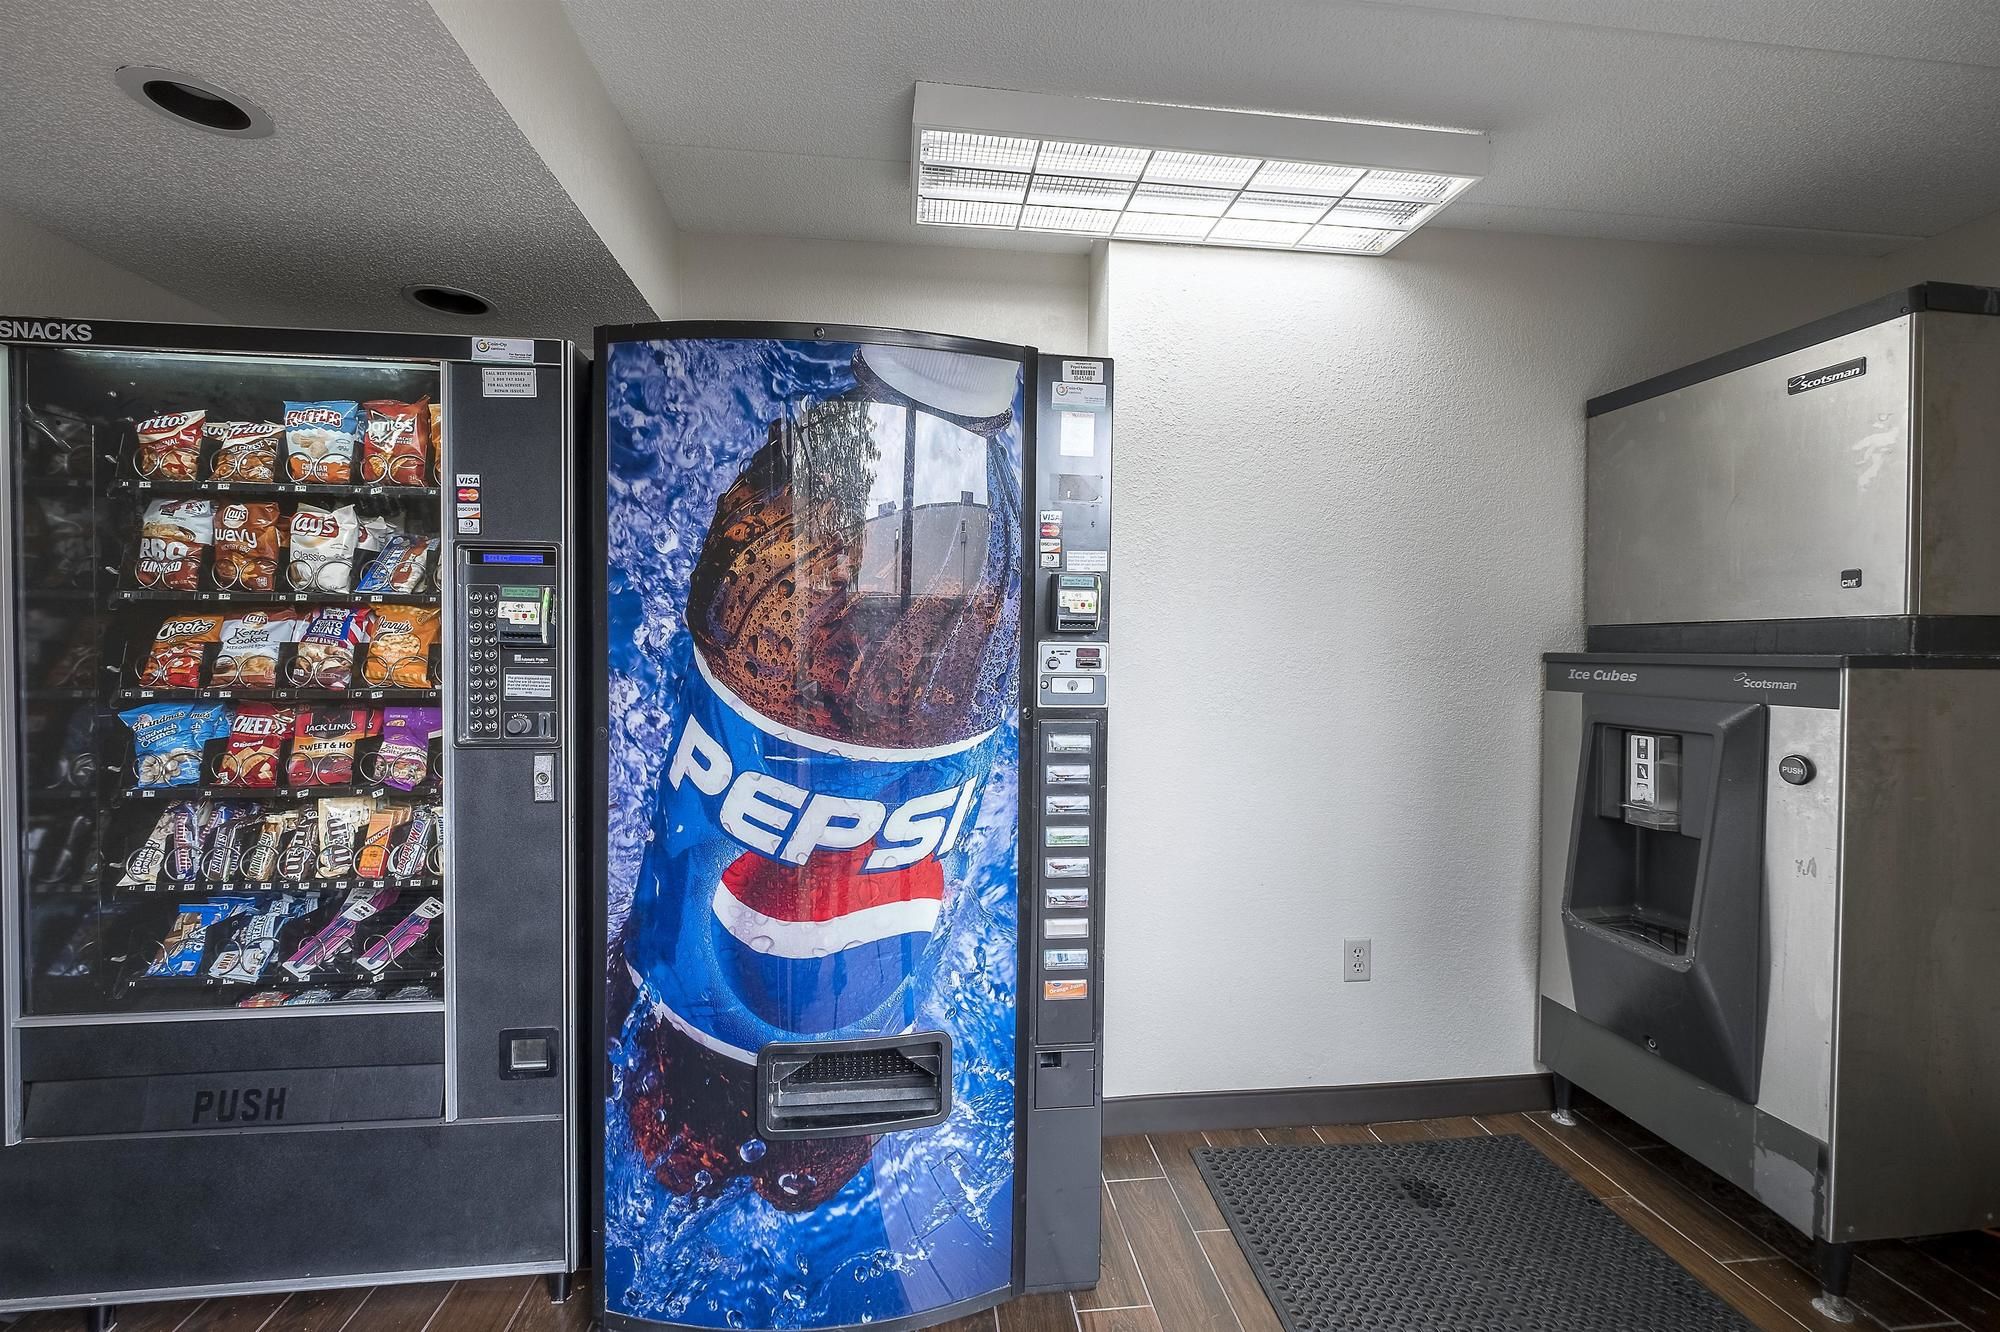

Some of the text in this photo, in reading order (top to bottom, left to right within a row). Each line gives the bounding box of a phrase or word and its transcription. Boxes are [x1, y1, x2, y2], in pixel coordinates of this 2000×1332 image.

[0, 320, 92, 341] SNACKS
[1800, 367, 1860, 390] Scotsman
[287, 409, 342, 428] RUFFLES
[224, 508, 248, 520] Lay's
[291, 514, 338, 537] Lay's
[215, 528, 258, 548] wavy
[140, 538, 188, 561] BBQ
[292, 550, 326, 562] Classic
[140, 560, 182, 574] FLAVED
[157, 619, 216, 641] Cheetos
[311, 626, 342, 636] SKINS
[227, 634, 269, 644] Cooked
[1568, 668, 1638, 682] Ice Cubes
[1743, 678, 1798, 690] Scotsman
[233, 716, 272, 734] CHEEZ
[305, 724, 328, 734] JACK
[298, 742, 330, 750] SWEET
[1782, 766, 1804, 775] PUSH
[669, 714, 978, 870] PEPSI
[192, 1087, 287, 1124] PUSH
